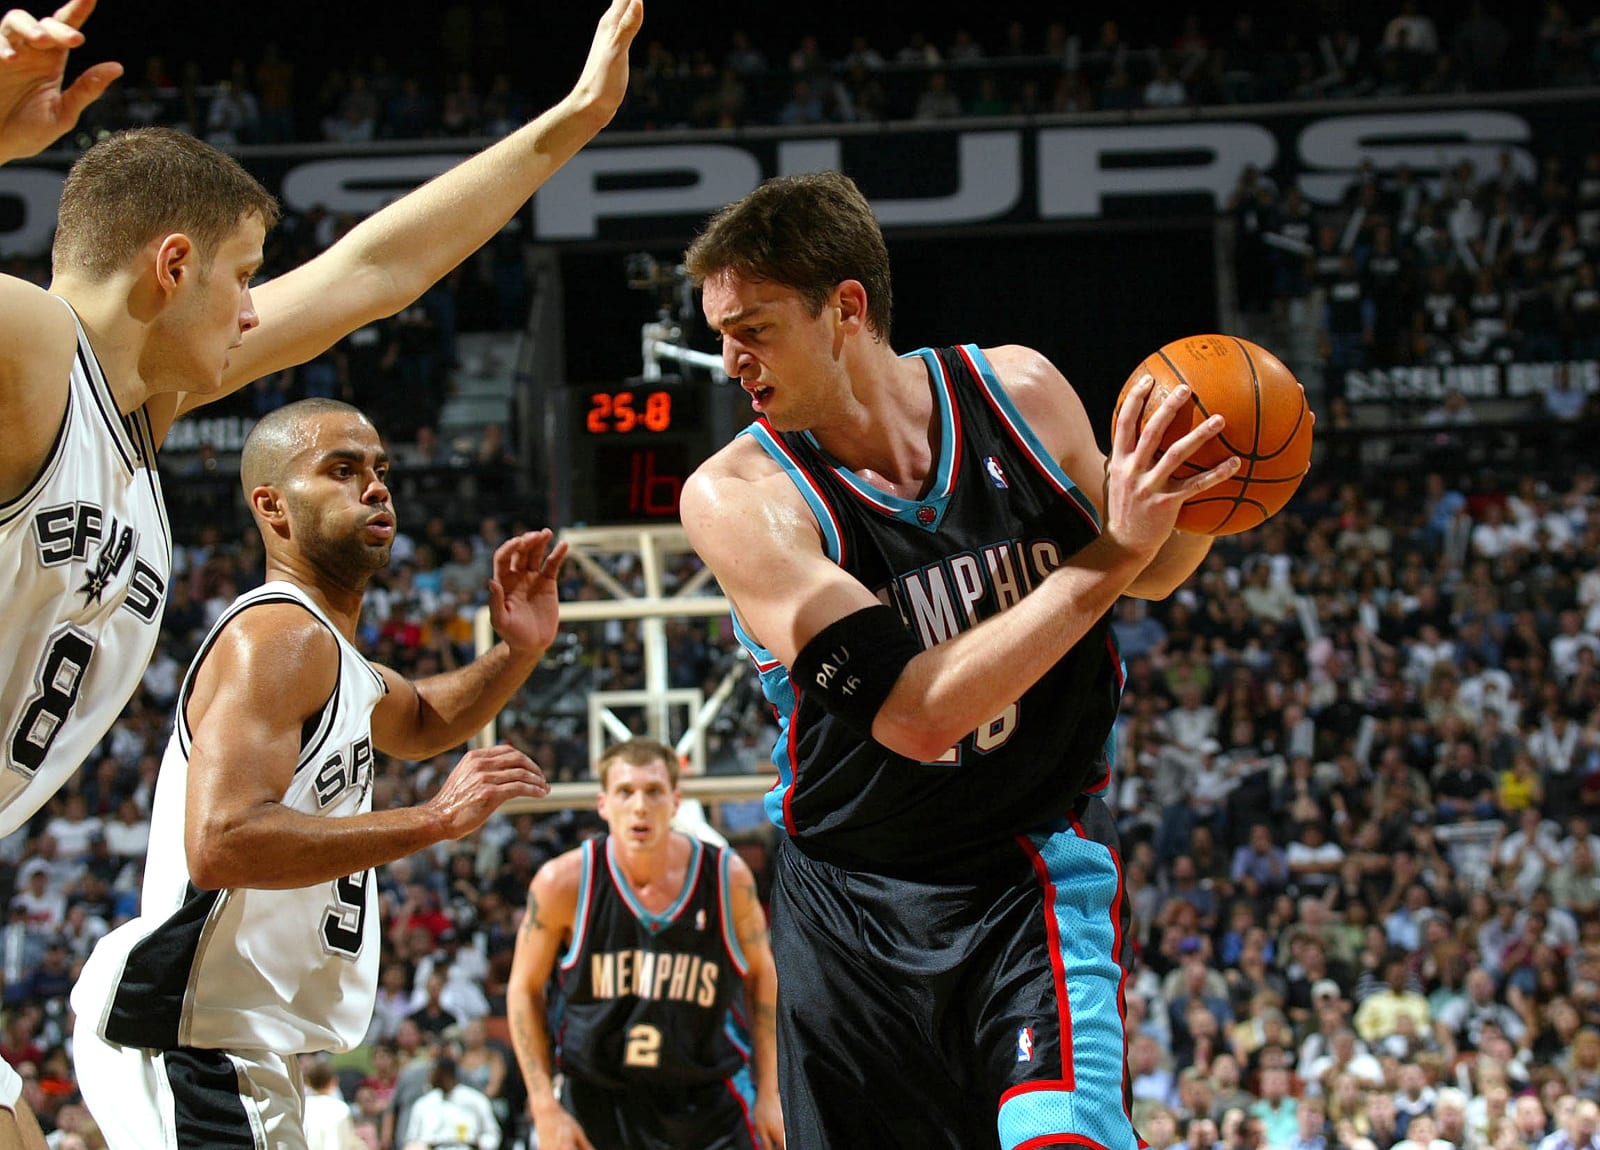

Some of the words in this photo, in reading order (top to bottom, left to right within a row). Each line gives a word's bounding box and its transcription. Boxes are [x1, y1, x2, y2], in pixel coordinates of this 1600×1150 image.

[586, 391, 672, 433] 25.8
[629, 450, 681, 515] 16
[32, 500, 166, 625] SPUS
[875, 537, 1062, 651] MPHIS
[815, 645, 850, 690] PAU
[841, 674, 862, 696] 16
[7, 621, 96, 780] 8
[318, 868, 370, 962] 9
[591, 949, 719, 1009] MEMPHIS
[624, 1023, 662, 1067] 2
